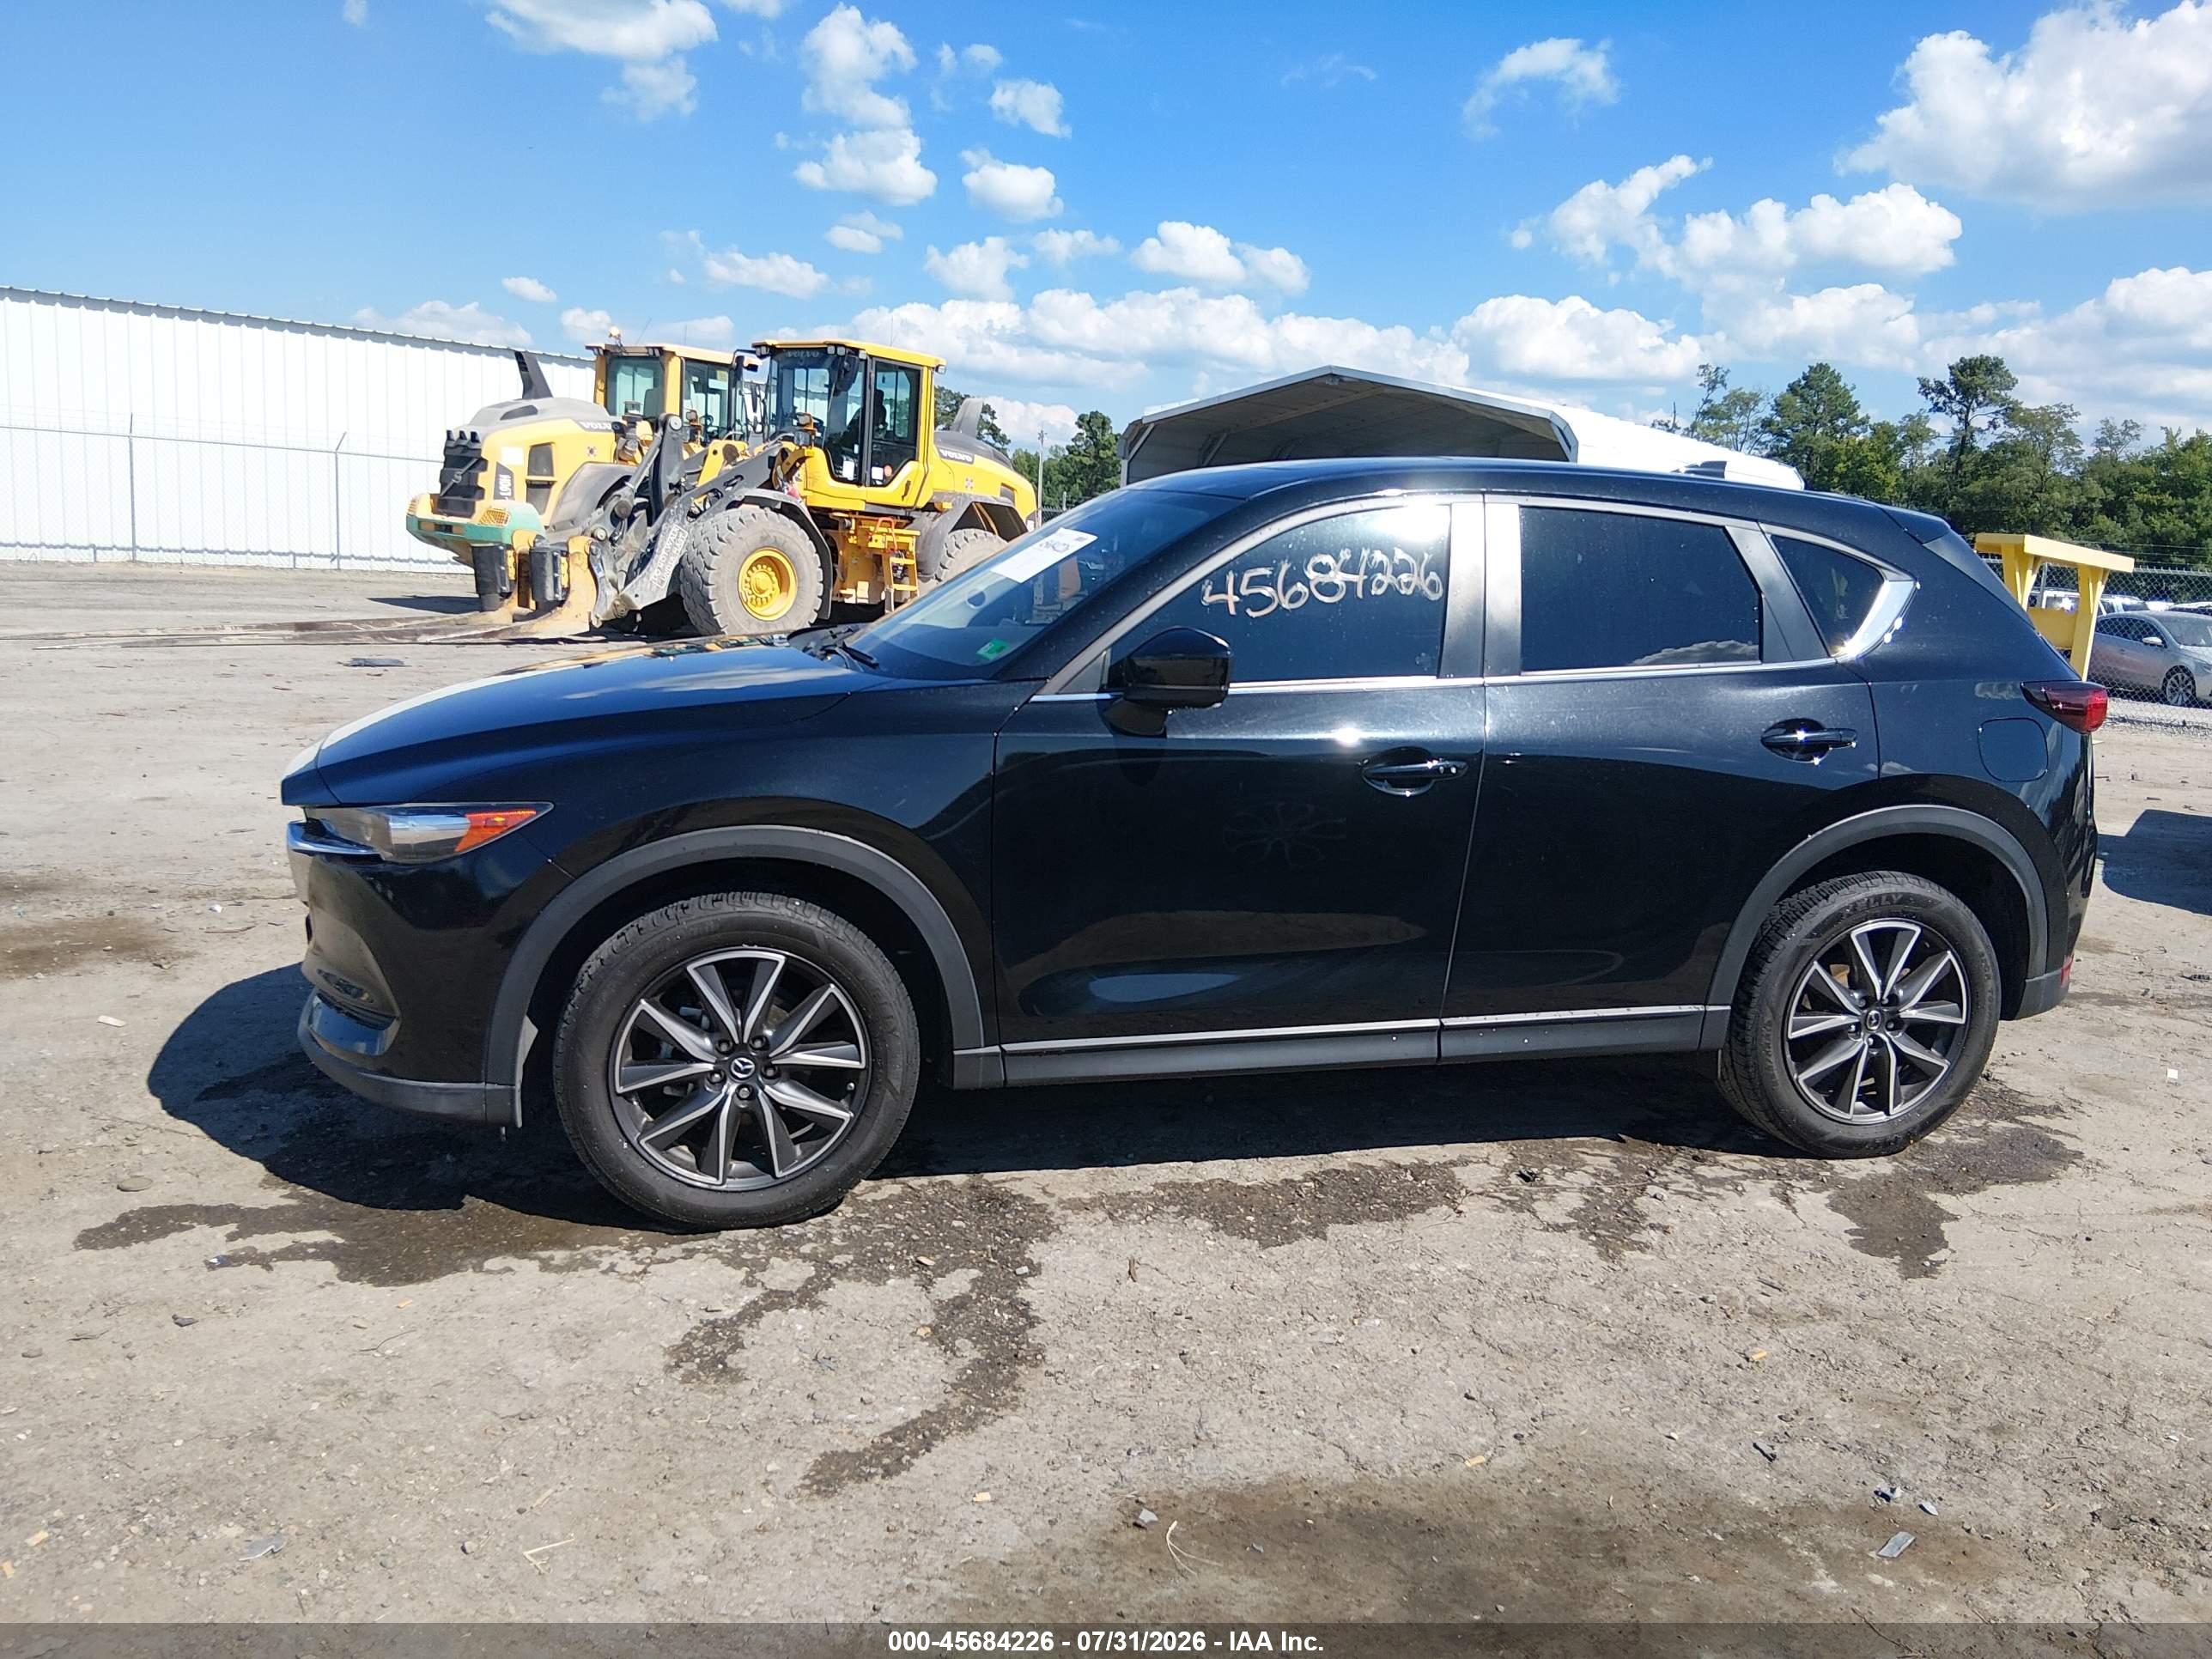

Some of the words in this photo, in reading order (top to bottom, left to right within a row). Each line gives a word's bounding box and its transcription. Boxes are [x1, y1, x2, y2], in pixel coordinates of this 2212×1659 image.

[578, 421, 611, 430] VOLV
[939, 448, 973, 463] VOLVO
[1200, 547, 1443, 618] 45684226
